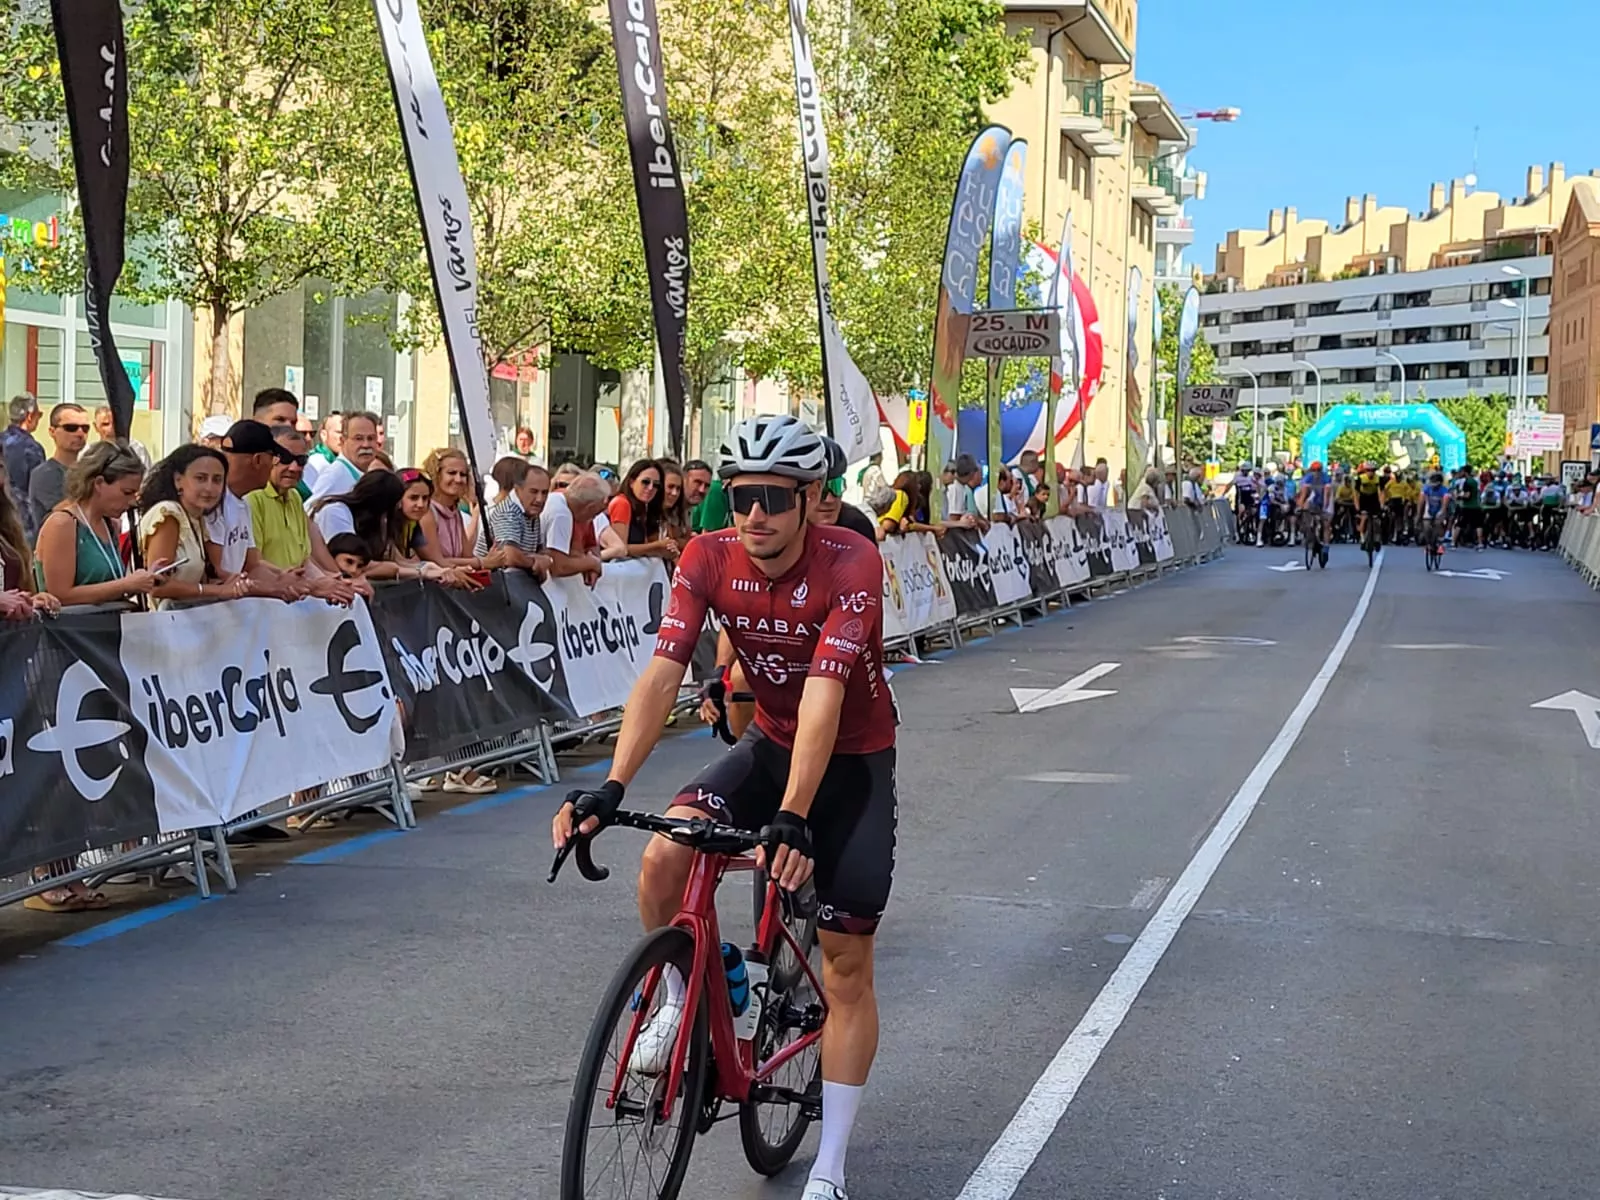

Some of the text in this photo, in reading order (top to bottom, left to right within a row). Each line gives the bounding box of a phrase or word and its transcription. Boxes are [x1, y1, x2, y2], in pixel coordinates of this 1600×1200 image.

[972, 314, 1049, 333] 25. M
[1191, 387, 1234, 400] 50. M
[561, 602, 640, 662] iberCaja
[824, 635, 862, 655] Mallorc
[141, 649, 302, 749] iberCaja
